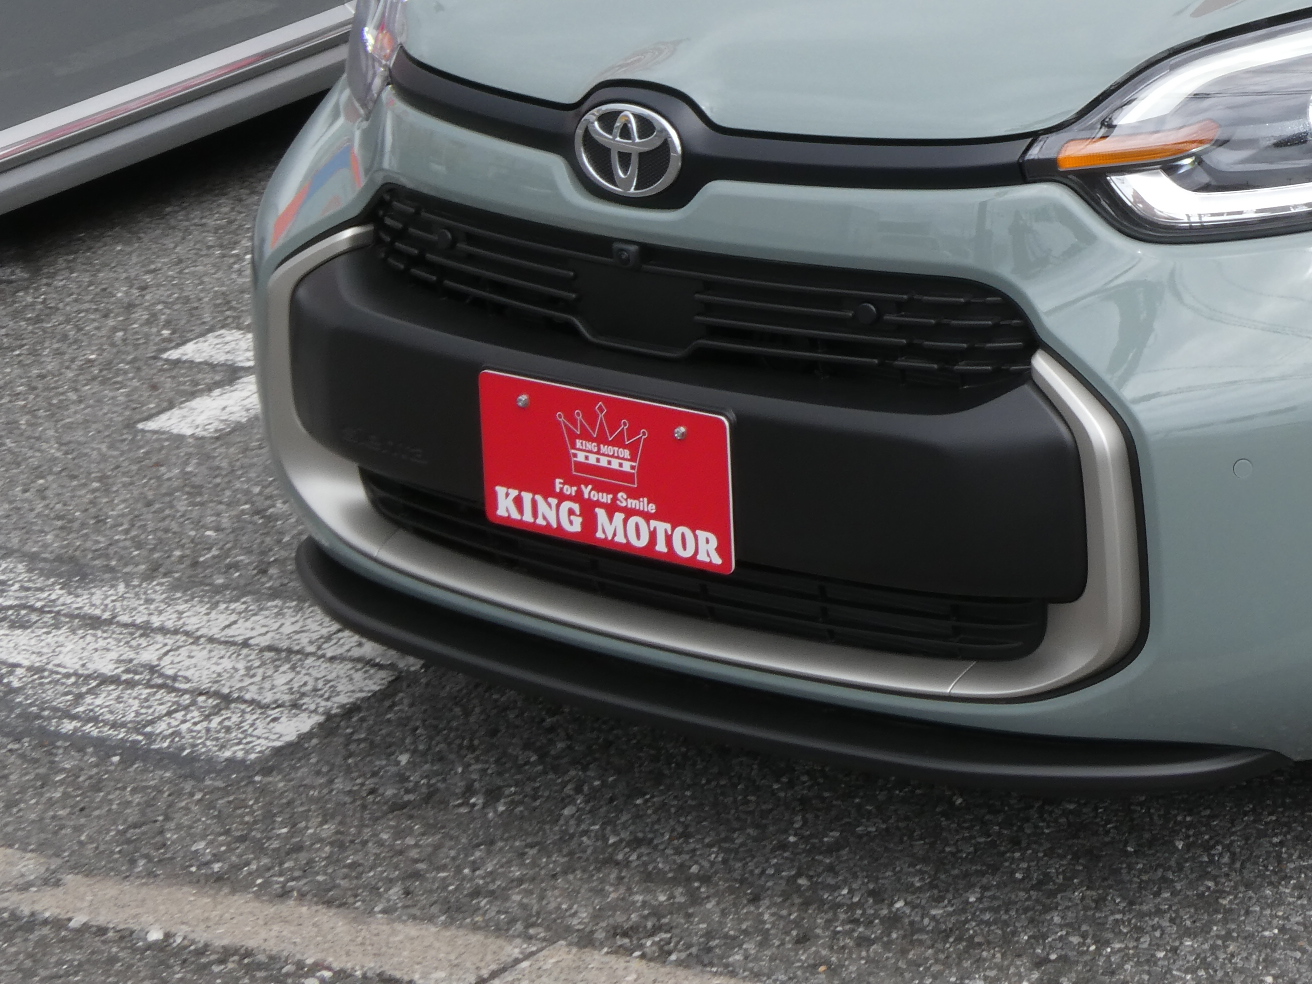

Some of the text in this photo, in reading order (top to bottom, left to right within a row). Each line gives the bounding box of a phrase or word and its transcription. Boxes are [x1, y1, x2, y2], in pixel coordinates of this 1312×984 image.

[575, 439, 630, 459] KING MOTOR
[555, 478, 656, 514] For Your Smile
[495, 486, 722, 564] KING MOTOR
